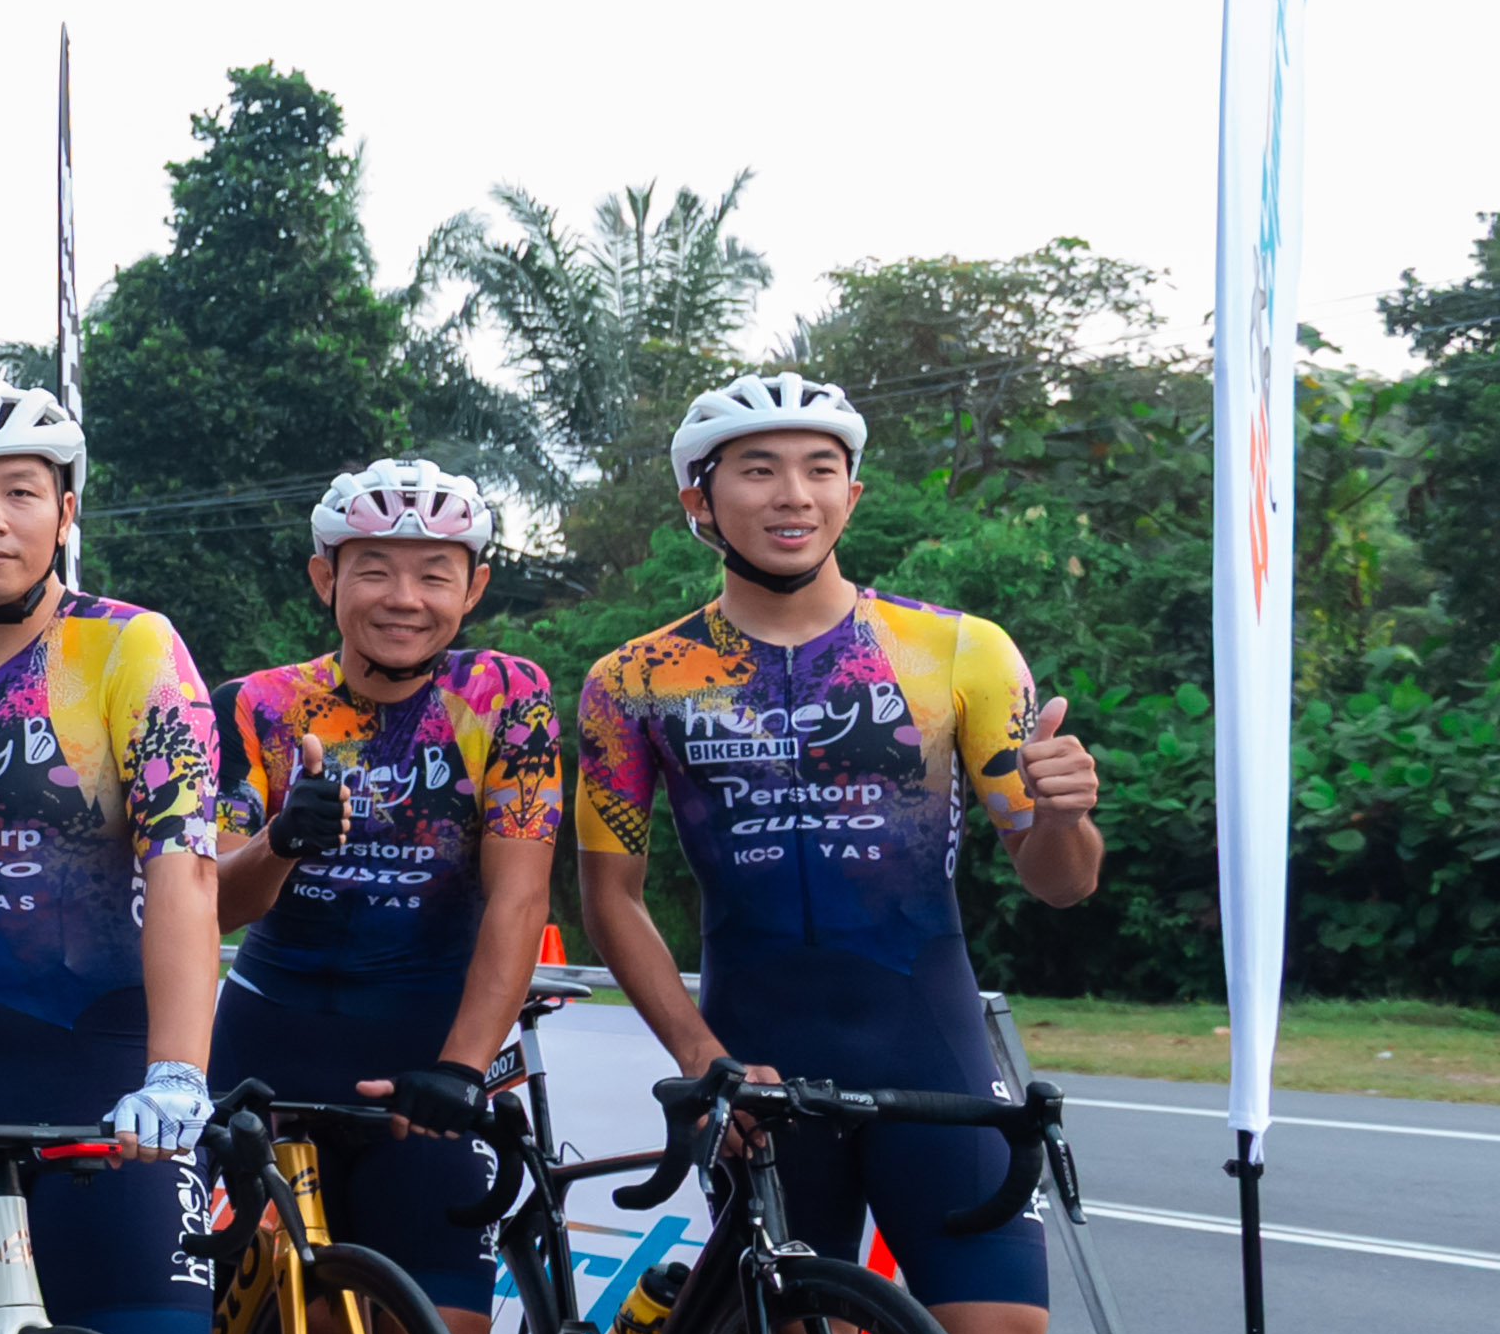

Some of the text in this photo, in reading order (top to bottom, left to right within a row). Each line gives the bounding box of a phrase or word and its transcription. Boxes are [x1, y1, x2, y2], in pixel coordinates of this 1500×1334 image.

[687, 740, 797, 764] BIKEBAJU
[708, 776, 883, 808] Perstorp
[731, 815, 886, 835] GUSTO
[299, 864, 433, 884] GUSTO
